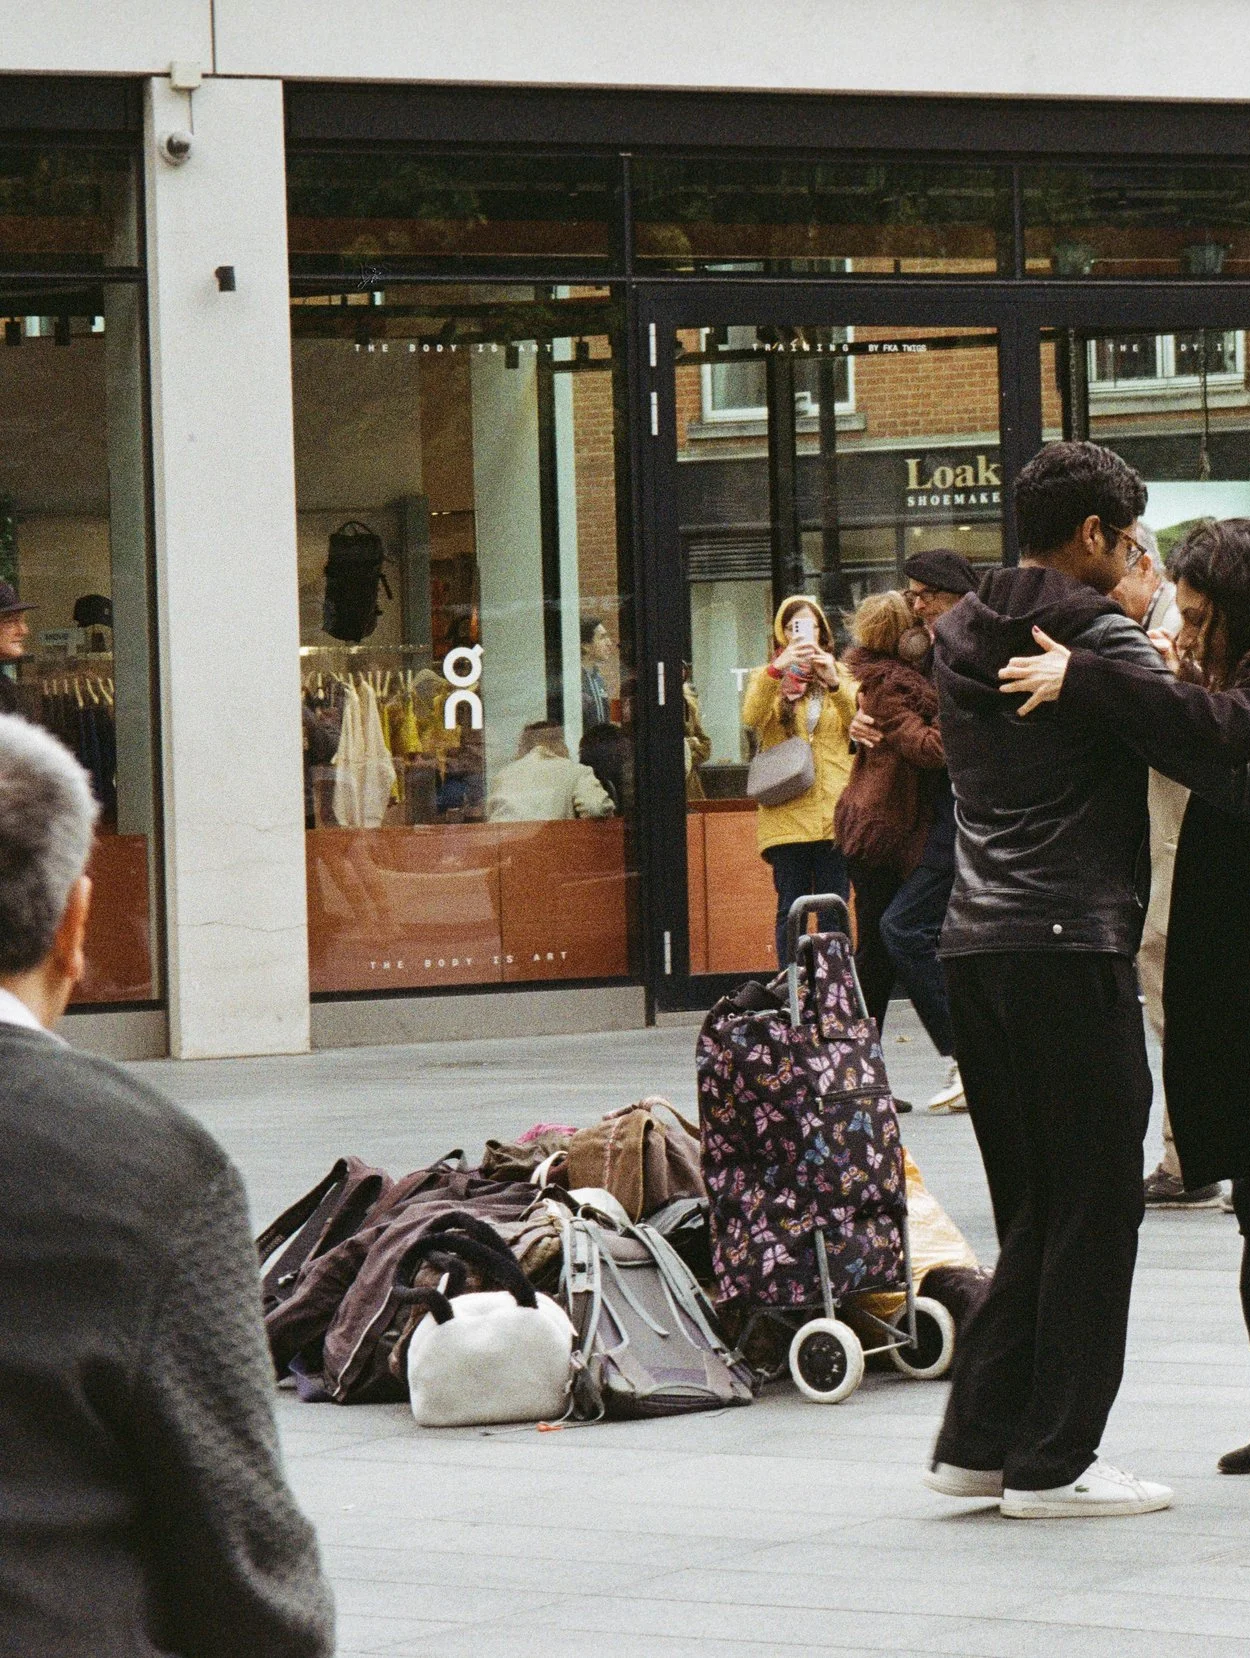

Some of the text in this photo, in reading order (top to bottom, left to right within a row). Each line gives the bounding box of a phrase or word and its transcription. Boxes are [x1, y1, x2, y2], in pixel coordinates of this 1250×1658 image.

[354, 343, 552, 353] THE BODY IS ART
[752, 343, 927, 352] TRAINING BY FKA TWIGS
[1108, 343, 1140, 353] THE
[369, 951, 568, 970] THE BODY IS ART
